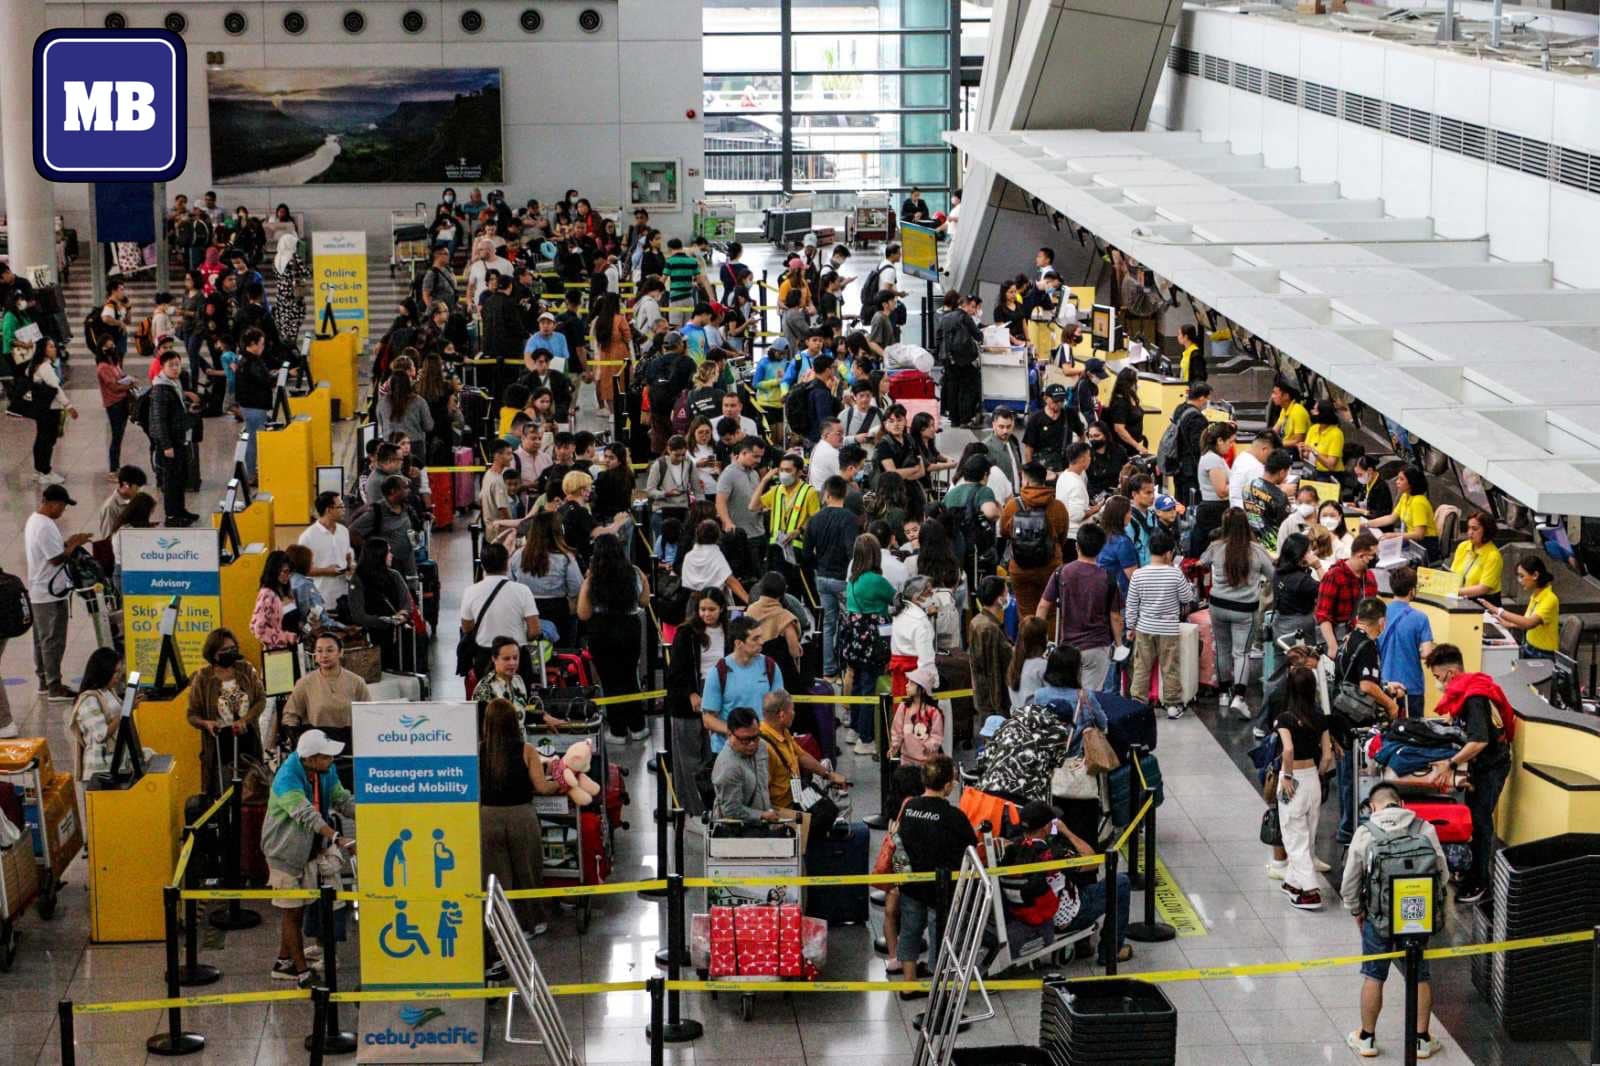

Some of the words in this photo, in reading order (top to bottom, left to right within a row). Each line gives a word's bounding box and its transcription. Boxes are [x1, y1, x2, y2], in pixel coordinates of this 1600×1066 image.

[324, 268, 357, 278] Online
[320, 281, 362, 291] Cck-in
[141, 551, 164, 560] cebu
[166, 550, 200, 562] pacific
[151, 578, 191, 590] Advisory
[132, 605, 158, 618] Skip
[132, 621, 152, 632] GO
[157, 621, 213, 632] LINE!
[378, 730, 408, 743] cebu
[410, 729, 453, 745] pacific
[368, 767, 434, 780] Passengers
[437, 766, 464, 777] with
[365, 782, 415, 793] Reduced
[418, 781, 468, 794] Mobility
[365, 1028, 410, 1045] cebu
[410, 1026, 479, 1049] pacific
